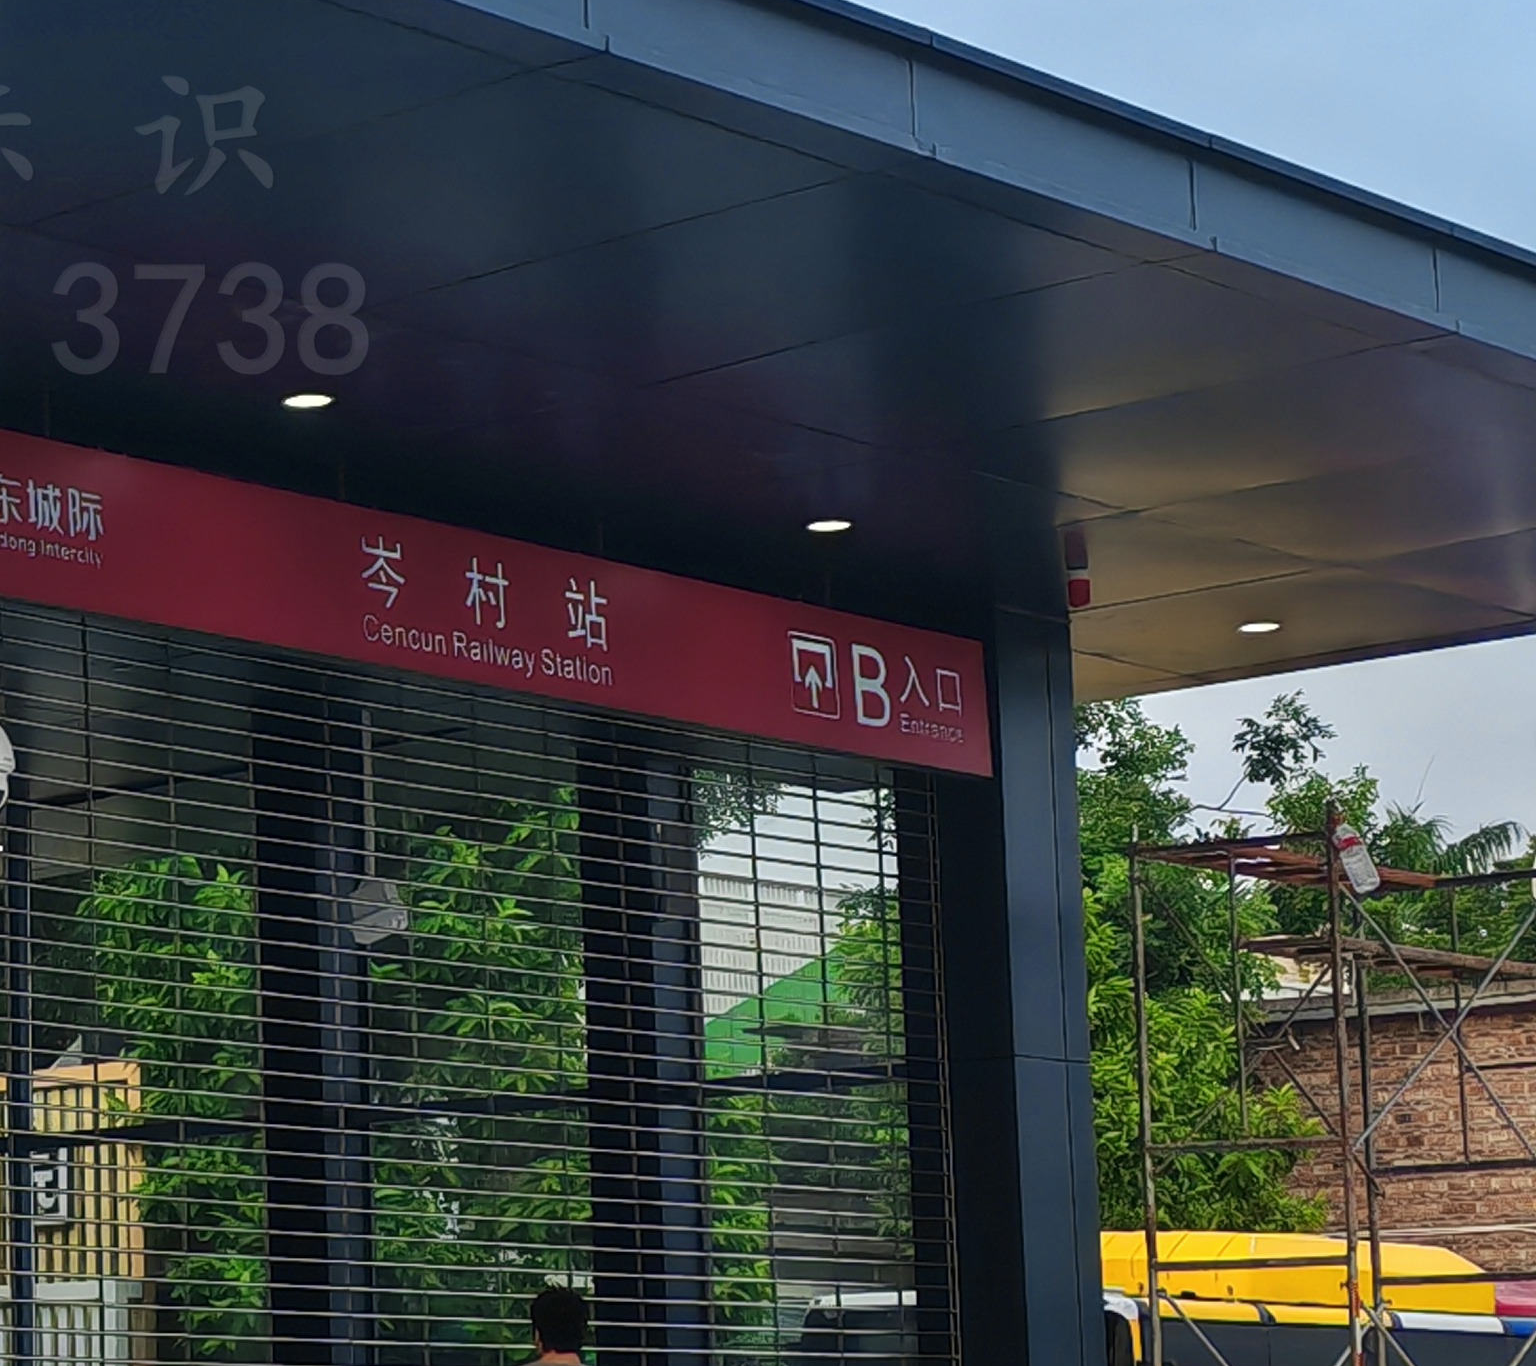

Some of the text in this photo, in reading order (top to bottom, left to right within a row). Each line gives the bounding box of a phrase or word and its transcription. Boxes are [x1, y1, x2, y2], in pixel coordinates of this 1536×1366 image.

[361, 535, 608, 653] 岑村站
[363, 614, 614, 686] Cencun Railway Station
[851, 643, 891, 727] B
[899, 655, 962, 717] 入口
